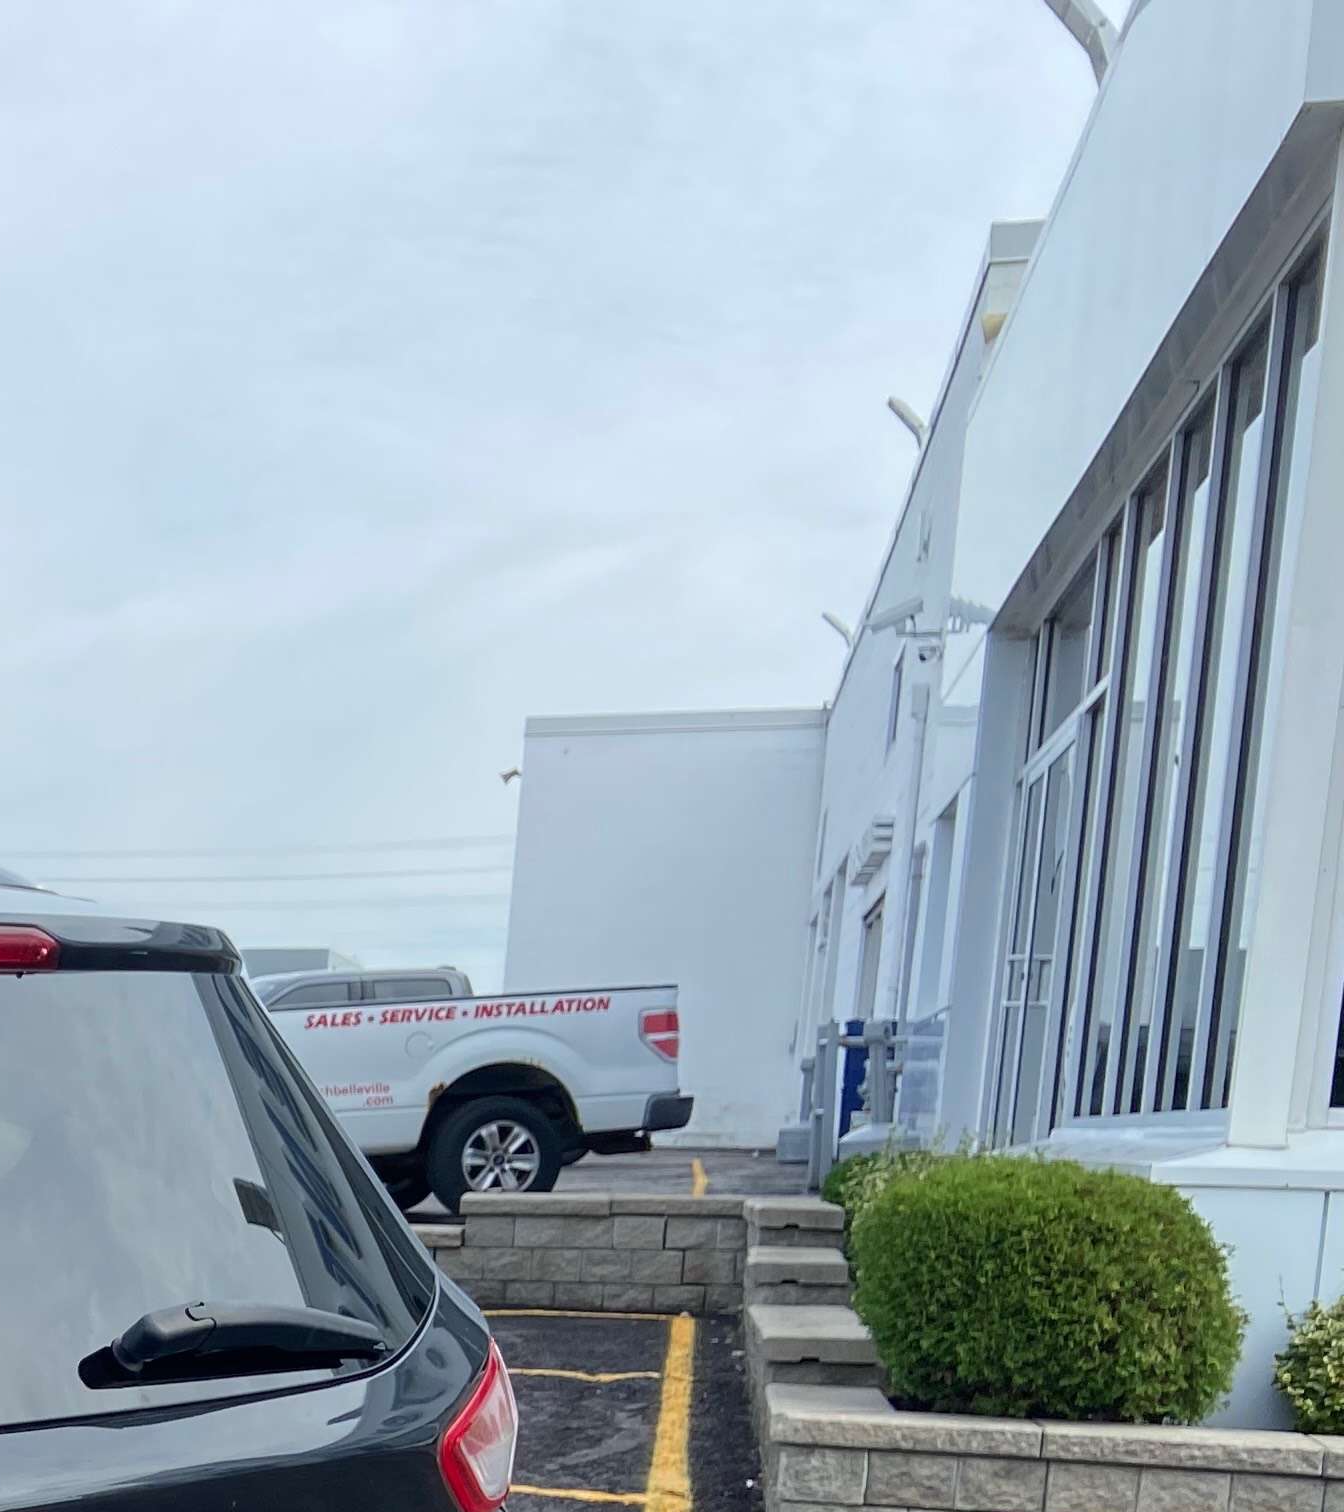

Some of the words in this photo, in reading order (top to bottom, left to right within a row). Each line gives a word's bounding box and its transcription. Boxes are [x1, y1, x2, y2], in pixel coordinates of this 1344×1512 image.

[304, 1011, 363, 1030] SALES
[379, 1005, 457, 1025] SERVICE
[474, 996, 611, 1019] INSTALLATION
